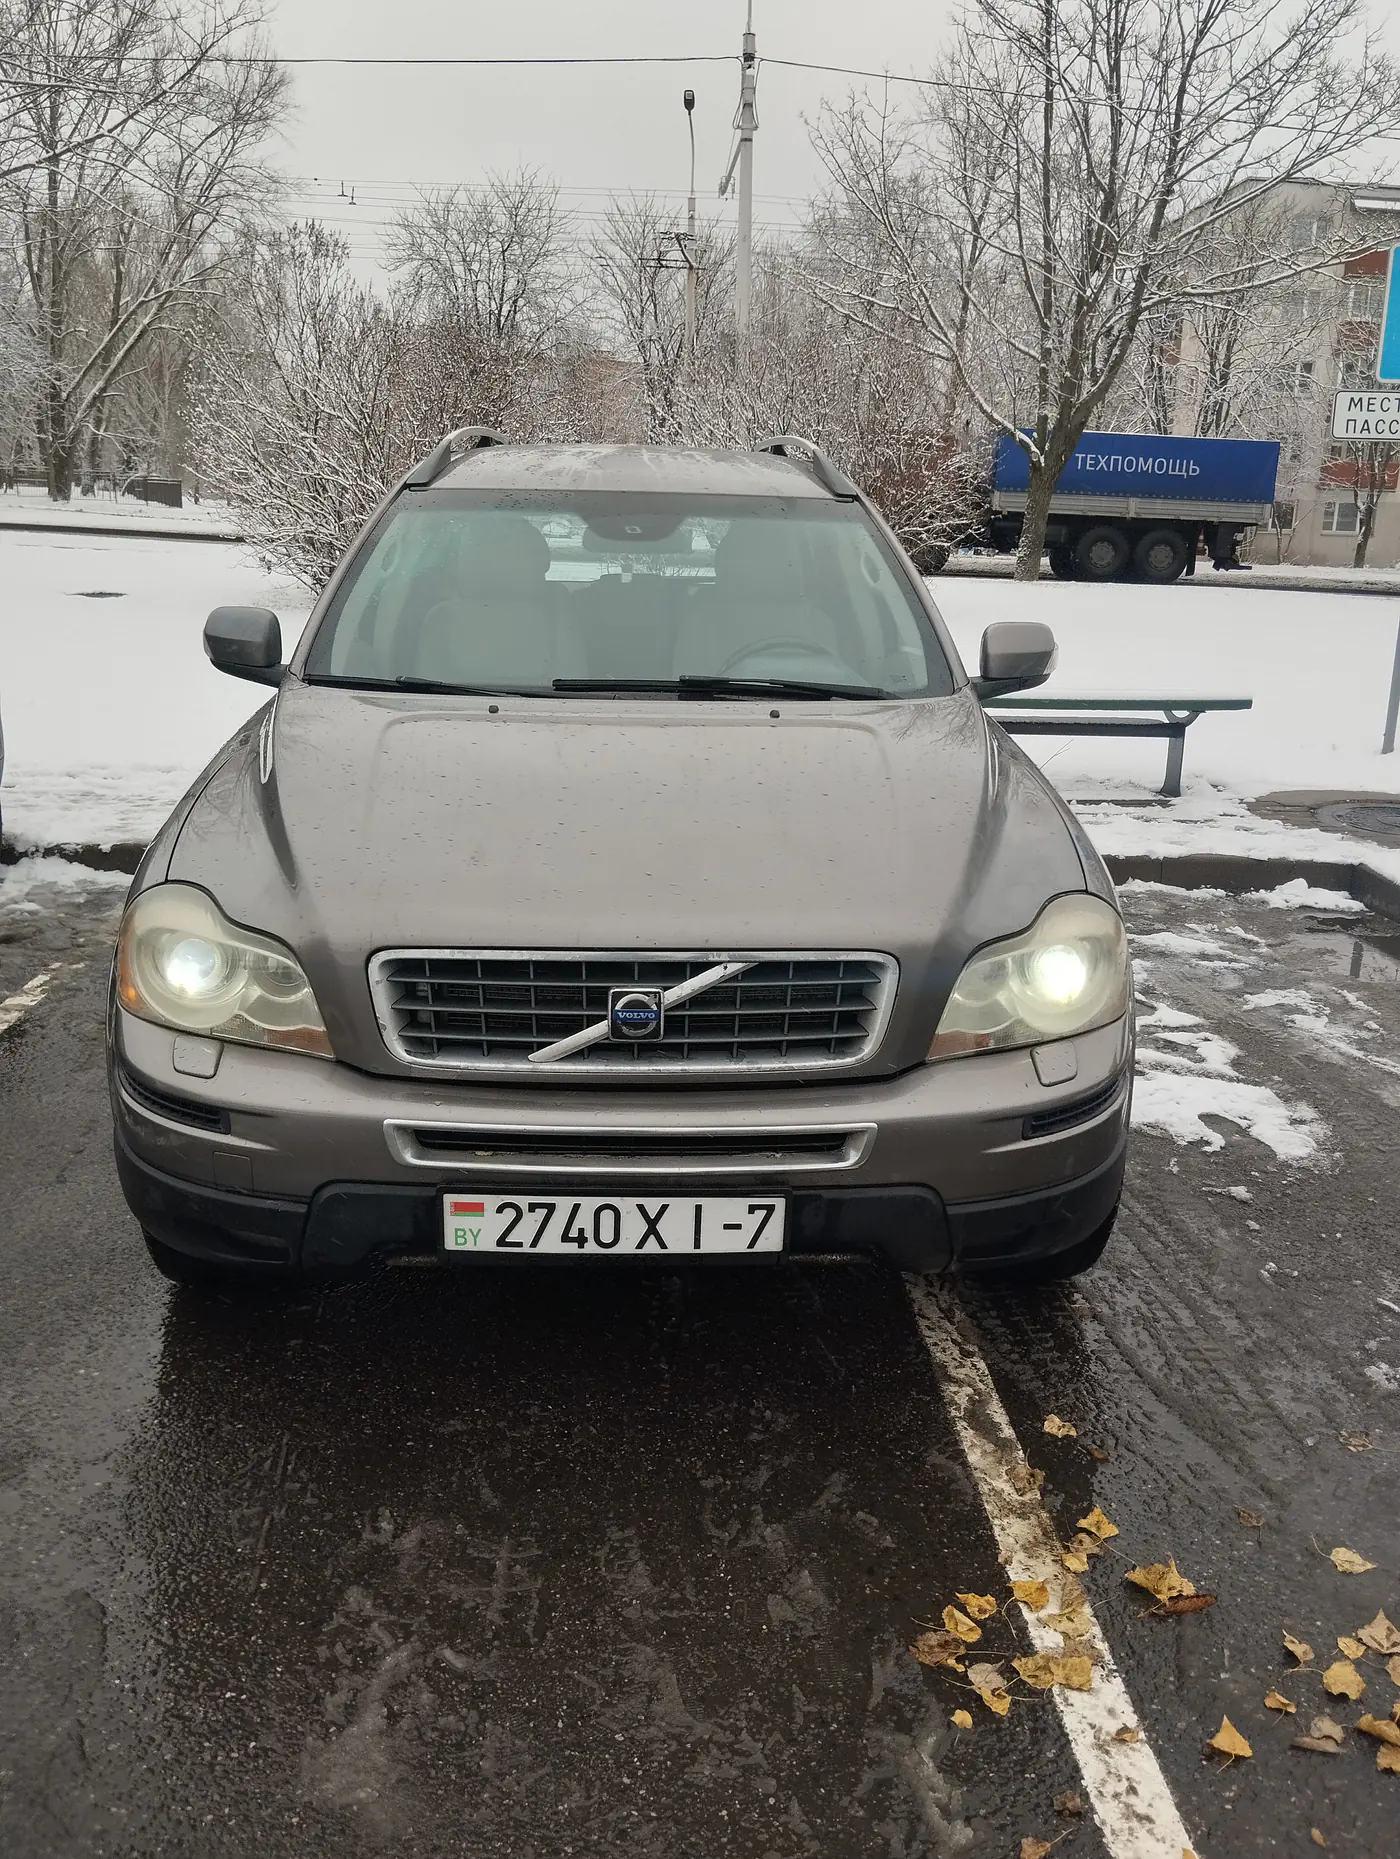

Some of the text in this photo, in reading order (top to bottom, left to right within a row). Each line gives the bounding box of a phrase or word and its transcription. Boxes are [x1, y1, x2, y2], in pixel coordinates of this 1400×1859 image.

[1345, 418, 1400, 435] ПАСС
[1075, 453, 1201, 478] ТЕХПОМОЩЬ
[454, 1227, 482, 1247] BY
